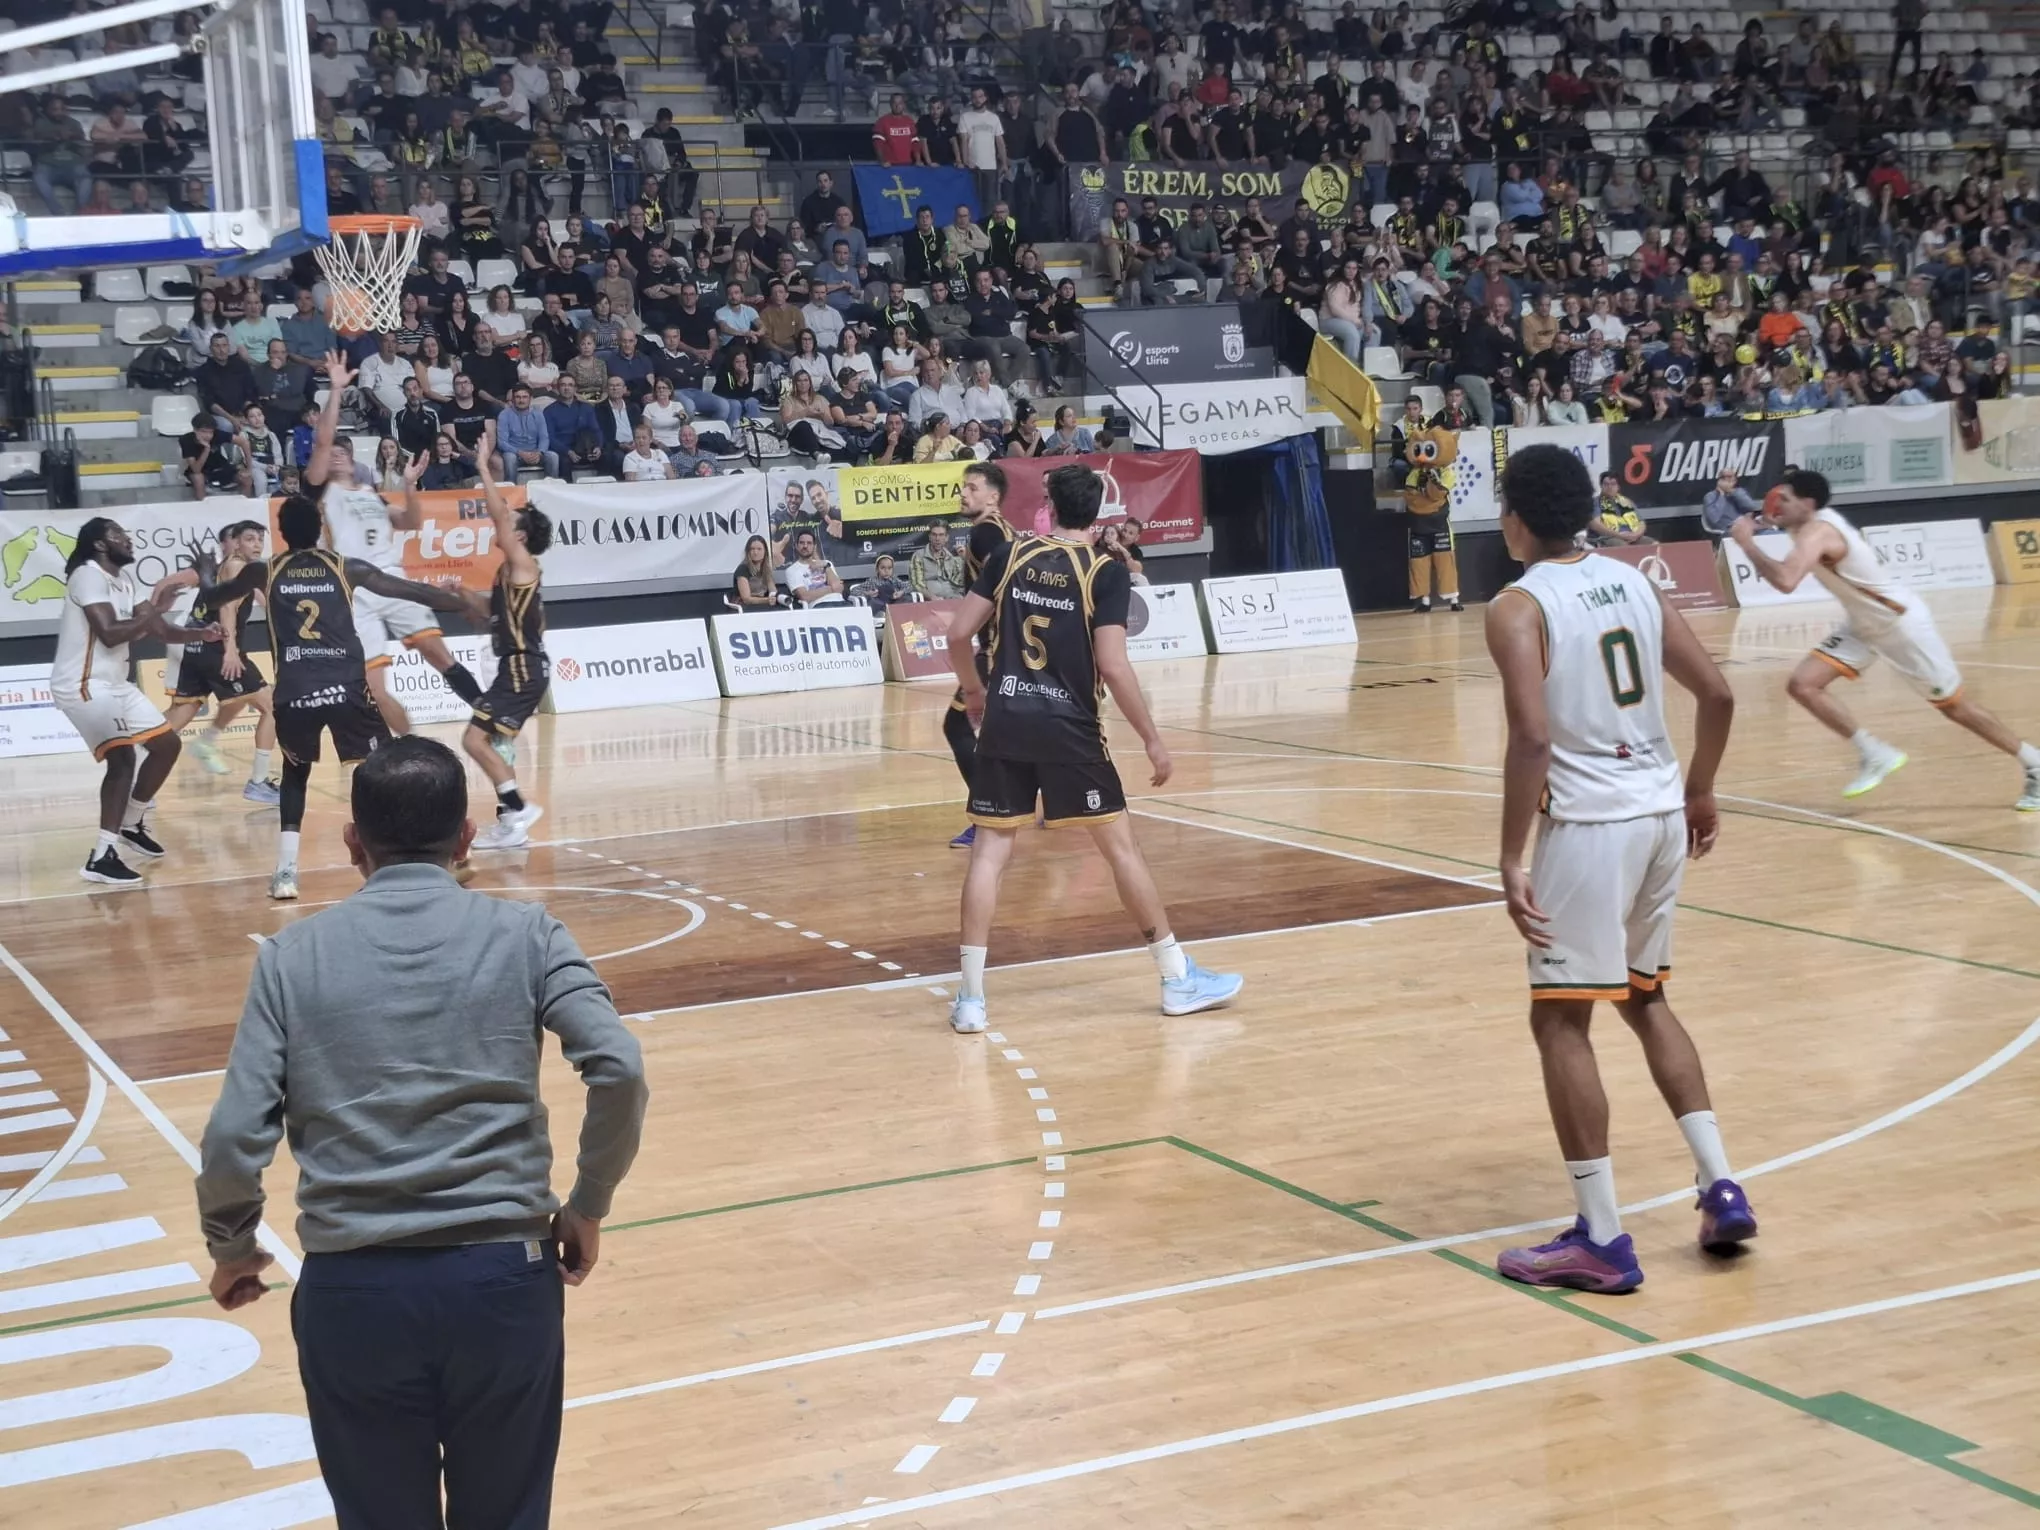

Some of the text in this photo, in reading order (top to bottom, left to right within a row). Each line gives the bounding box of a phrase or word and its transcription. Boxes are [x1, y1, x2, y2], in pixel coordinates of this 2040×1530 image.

[1122, 166, 1282, 199] ÉREM, SOM
[1145, 344, 1179, 357] esports
[1133, 395, 1303, 427] VEGAMAR
[1188, 428, 1261, 445] BODEGAS
[1659, 436, 1771, 483] DARIMO
[852, 473, 912, 487] NO SOMOS
[550, 507, 760, 546] AR CASA DOMINGO
[1149, 517, 1194, 530] Gourmet
[279, 583, 335, 594] Delibreads
[1025, 568, 1069, 589] D. RIVAS
[1012, 587, 1075, 612] Delibreads
[295, 599, 321, 640] 2
[301, 647, 346, 657] DOMENECH
[1021, 614, 1051, 671] 5
[585, 647, 705, 679] monrabal
[734, 656, 871, 677] Recambios del automóvil
[1598, 625, 1646, 709] 0
[1017, 681, 1072, 700] DOMENECH
